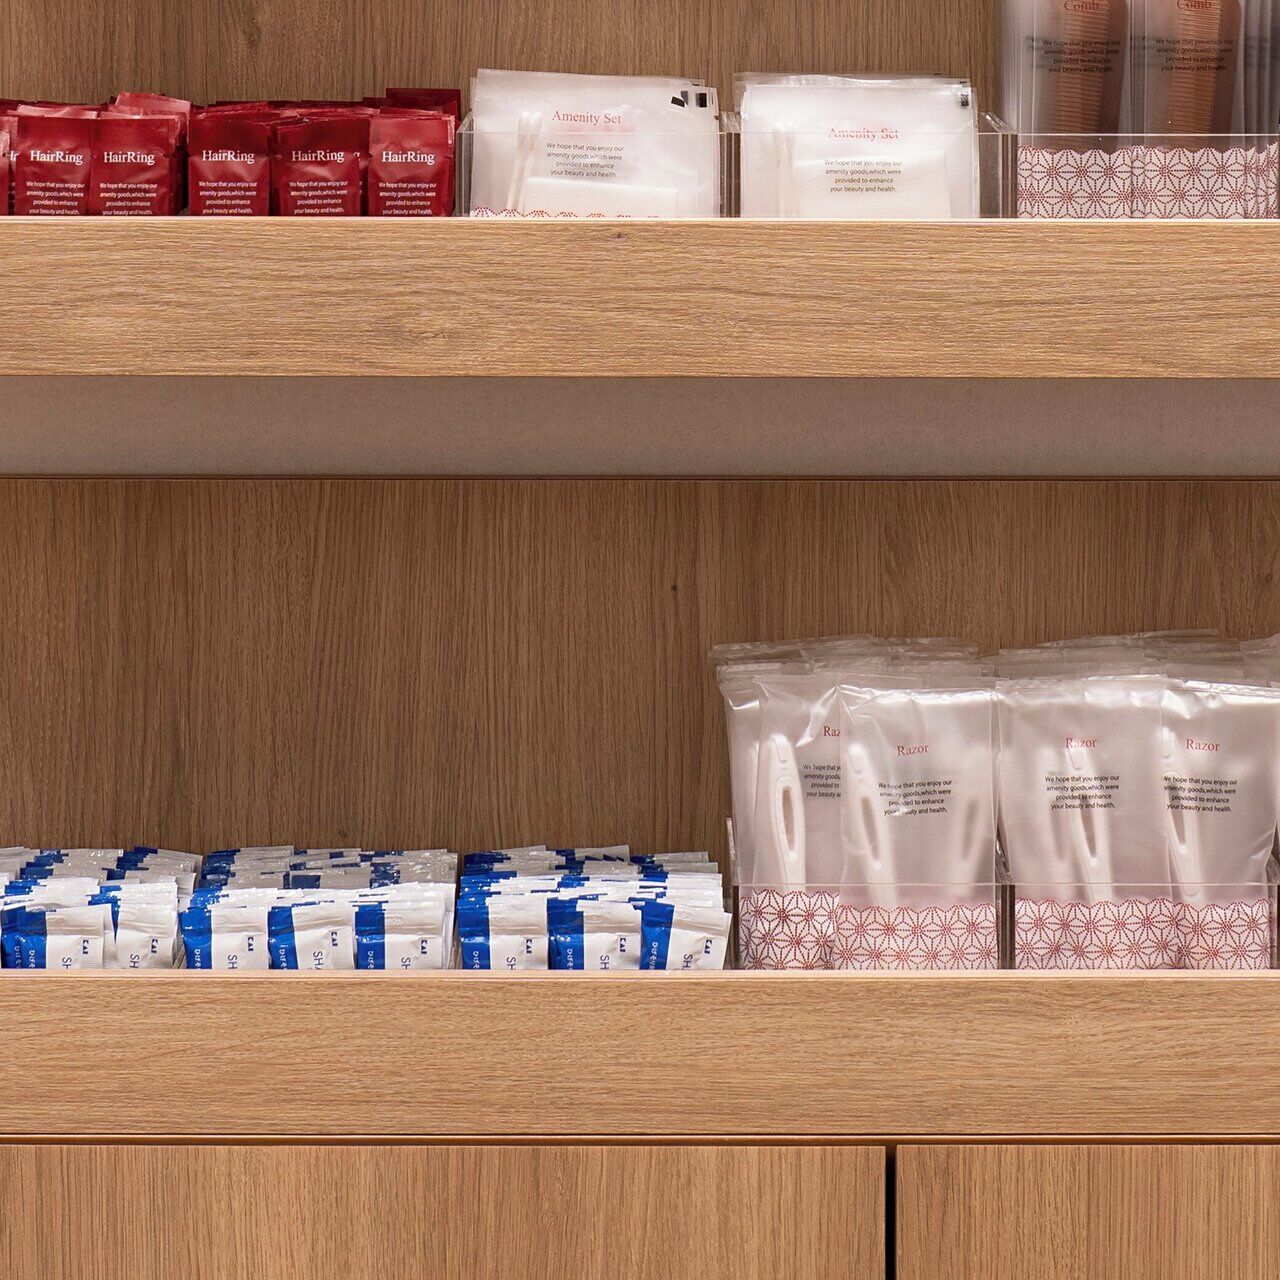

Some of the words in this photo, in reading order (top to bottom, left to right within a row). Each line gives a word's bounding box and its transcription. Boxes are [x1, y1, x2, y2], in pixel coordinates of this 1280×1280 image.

[1064, 0, 1099, 11] Comb
[552, 110, 600, 126] Amenity
[604, 113, 622, 124] Set
[30, 150, 83, 165] HairRing
[103, 151, 155, 165] HairRing
[202, 150, 255, 164] HairRing
[292, 150, 345, 163] HairRing
[382, 151, 435, 165] HairRing
[823, 725, 841, 737] Raz
[897, 744, 929, 756] Razor
[1066, 738, 1097, 748] Razor
[1186, 739, 1220, 751] Razor
[704, 939, 712, 955] KAI
[313, 951, 324, 969] SH
